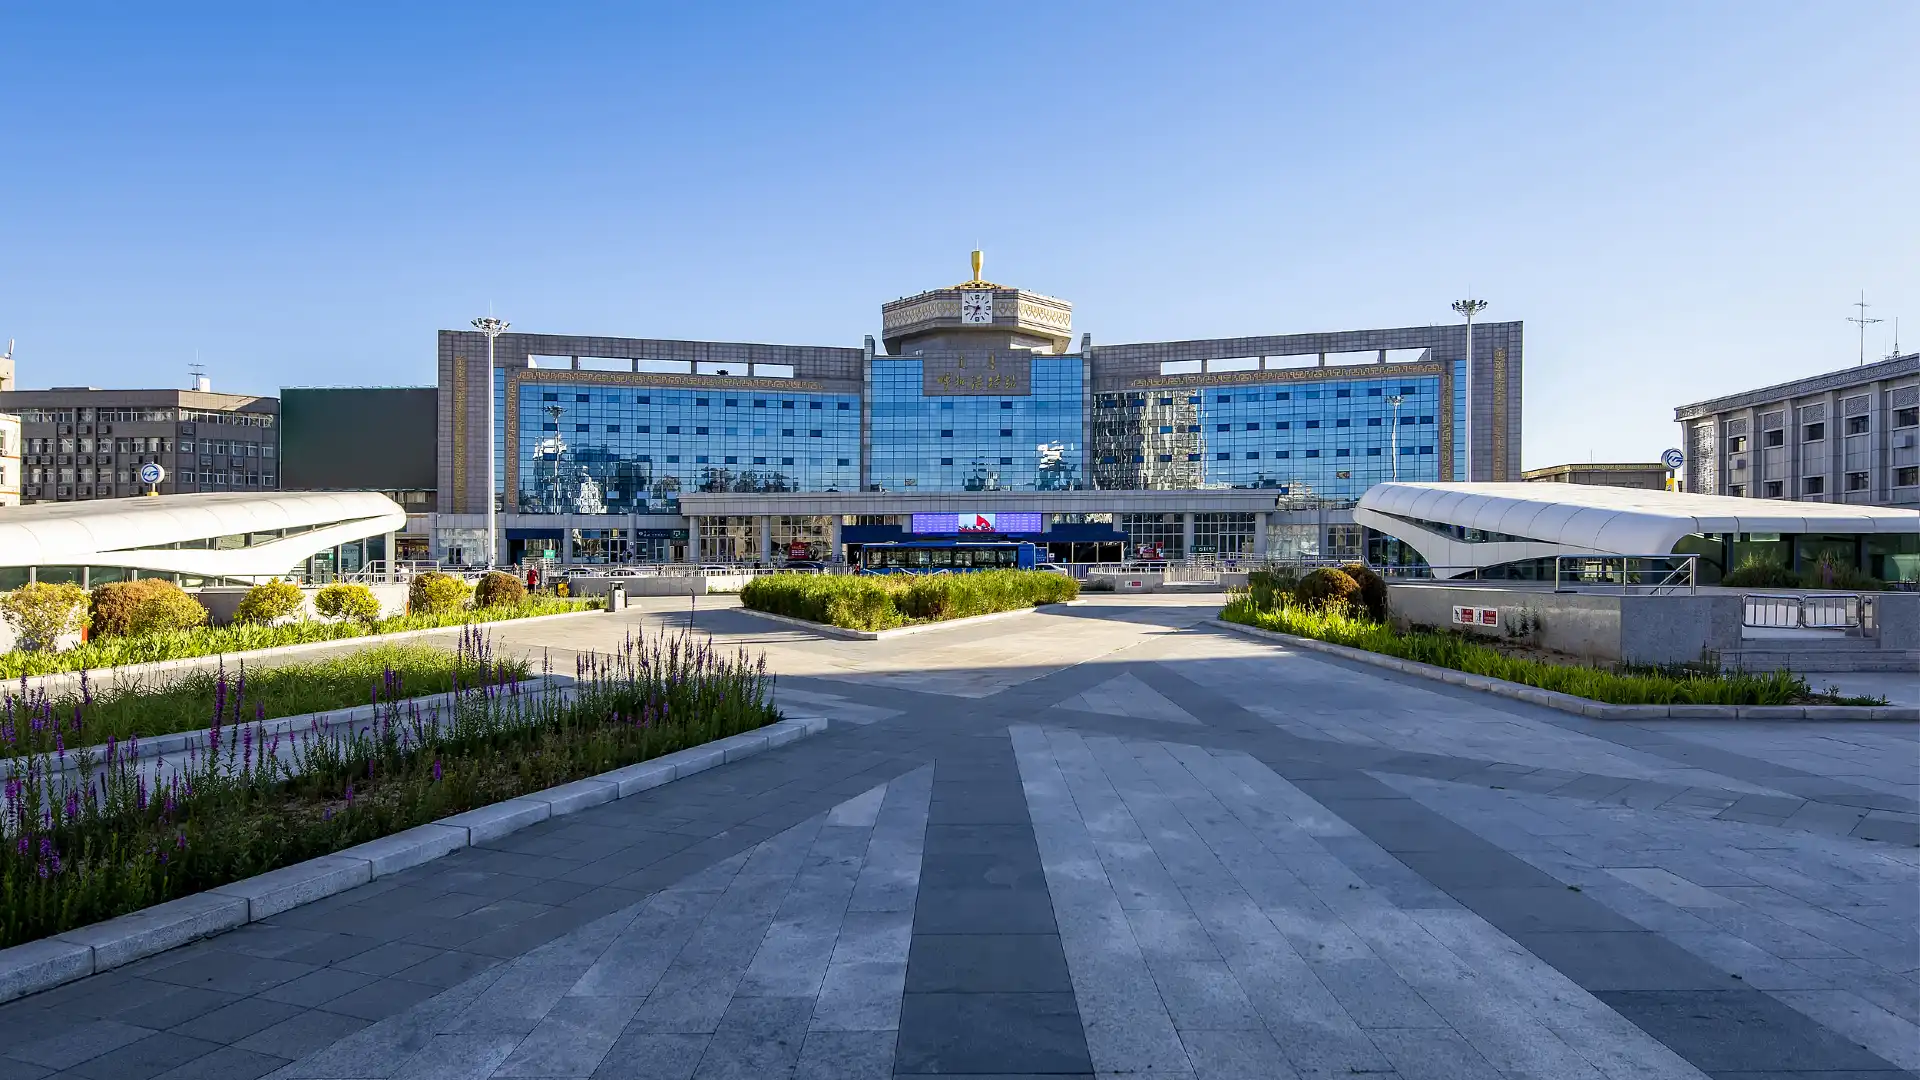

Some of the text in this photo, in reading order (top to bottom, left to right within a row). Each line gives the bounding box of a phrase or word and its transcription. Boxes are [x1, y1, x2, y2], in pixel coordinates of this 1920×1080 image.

[937, 372, 1017, 391] 呼和浩特站
